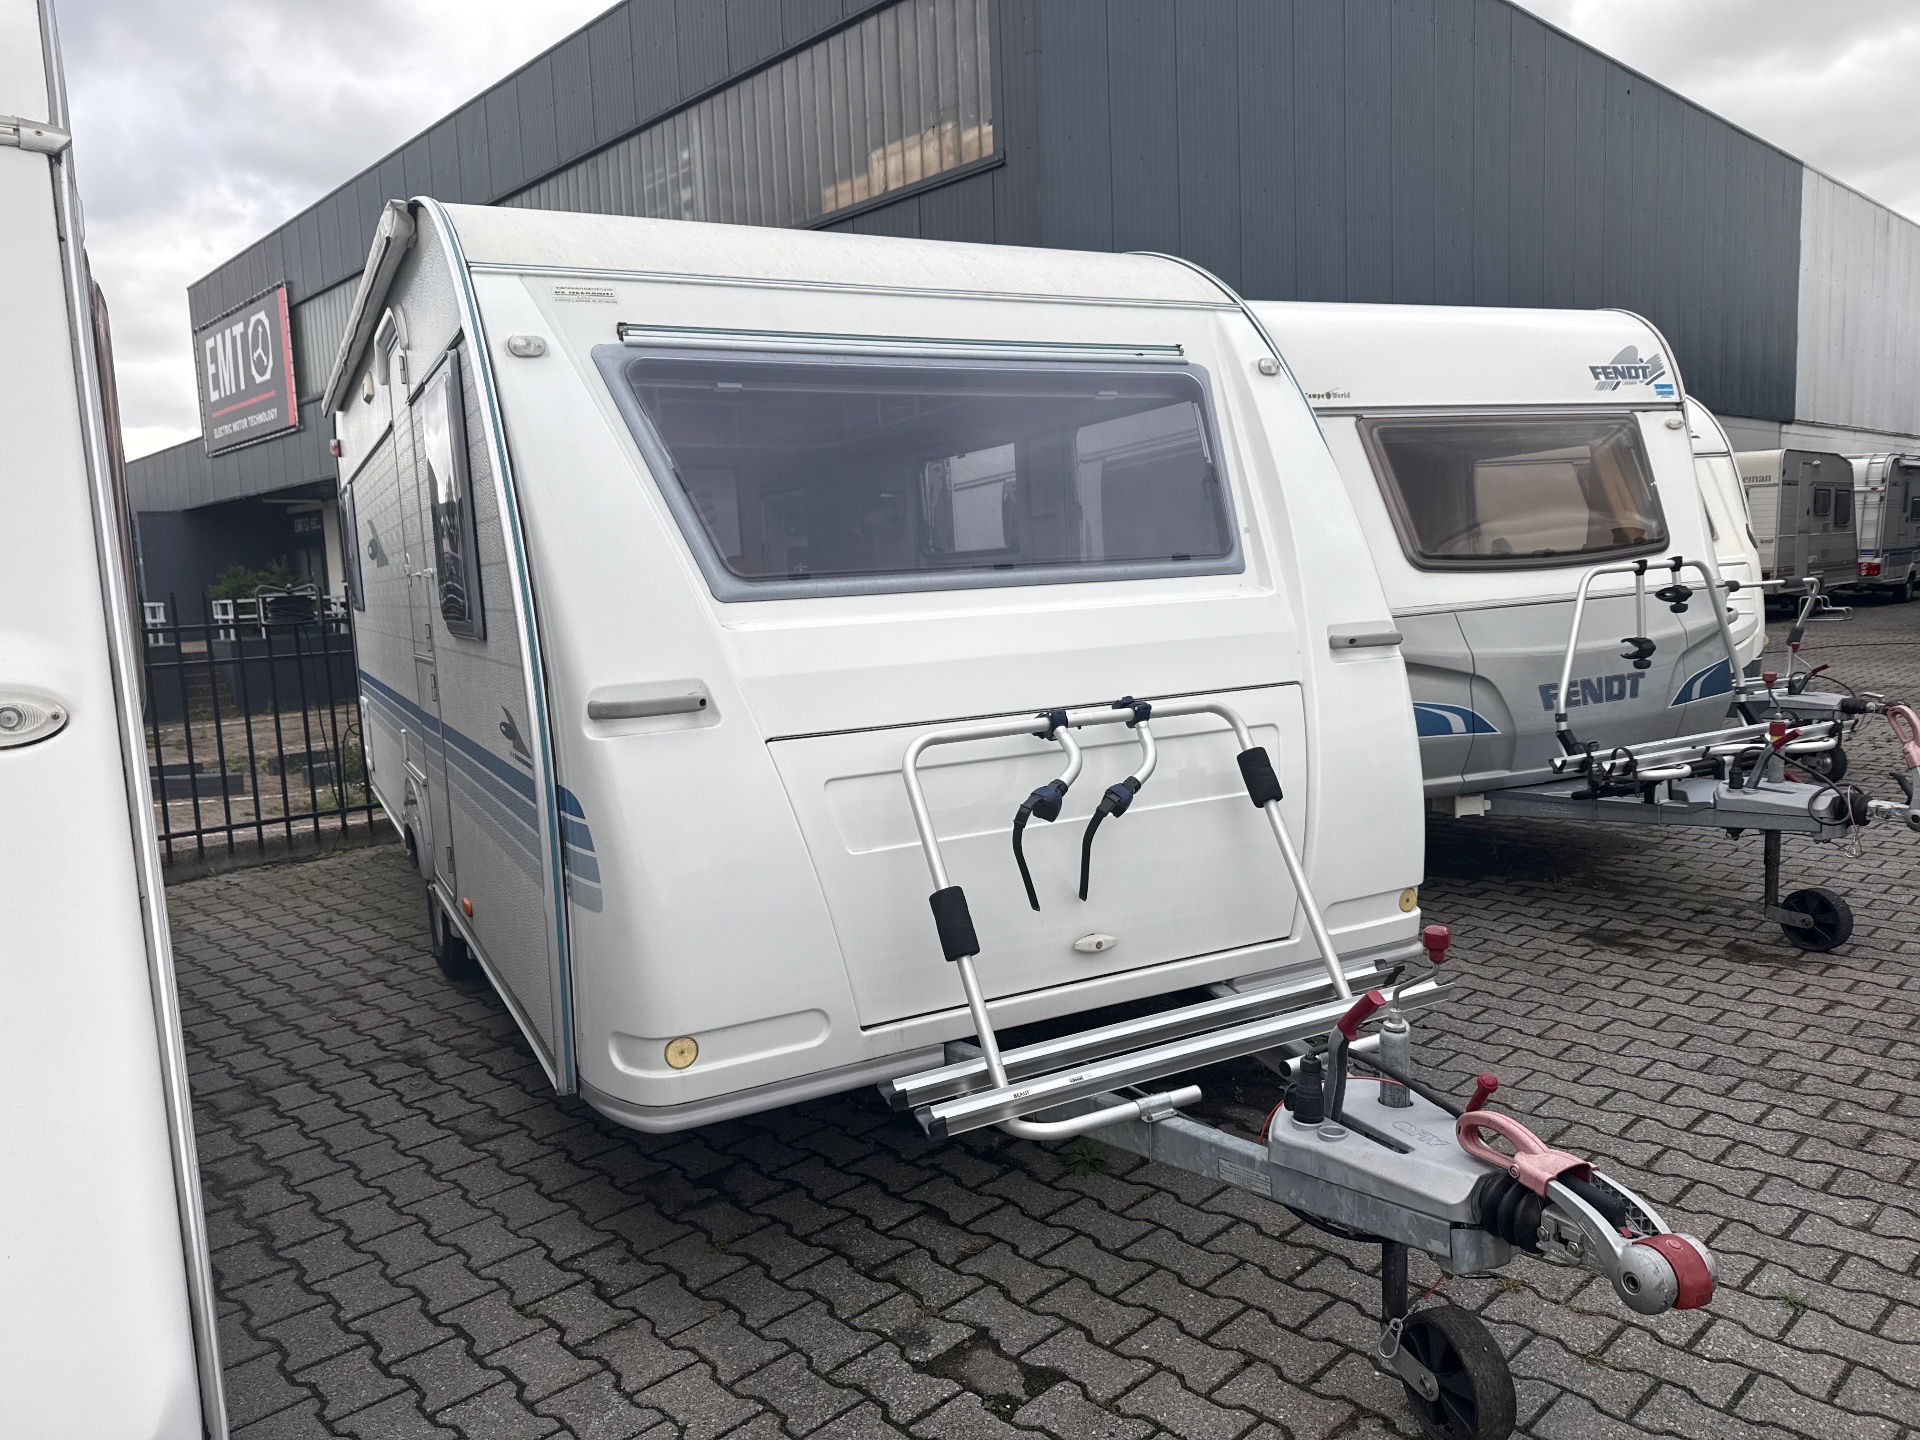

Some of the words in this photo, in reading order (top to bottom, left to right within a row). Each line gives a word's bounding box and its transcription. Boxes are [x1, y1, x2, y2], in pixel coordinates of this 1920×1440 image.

[205, 321, 245, 402] EMT
[1589, 365, 1650, 380] FENDT
[213, 422, 233, 440] ELECTRIC
[232, 417, 249, 433] MOTOR
[247, 407, 278, 428] TECHNOLOGY
[1538, 671, 1645, 711] FENDT
